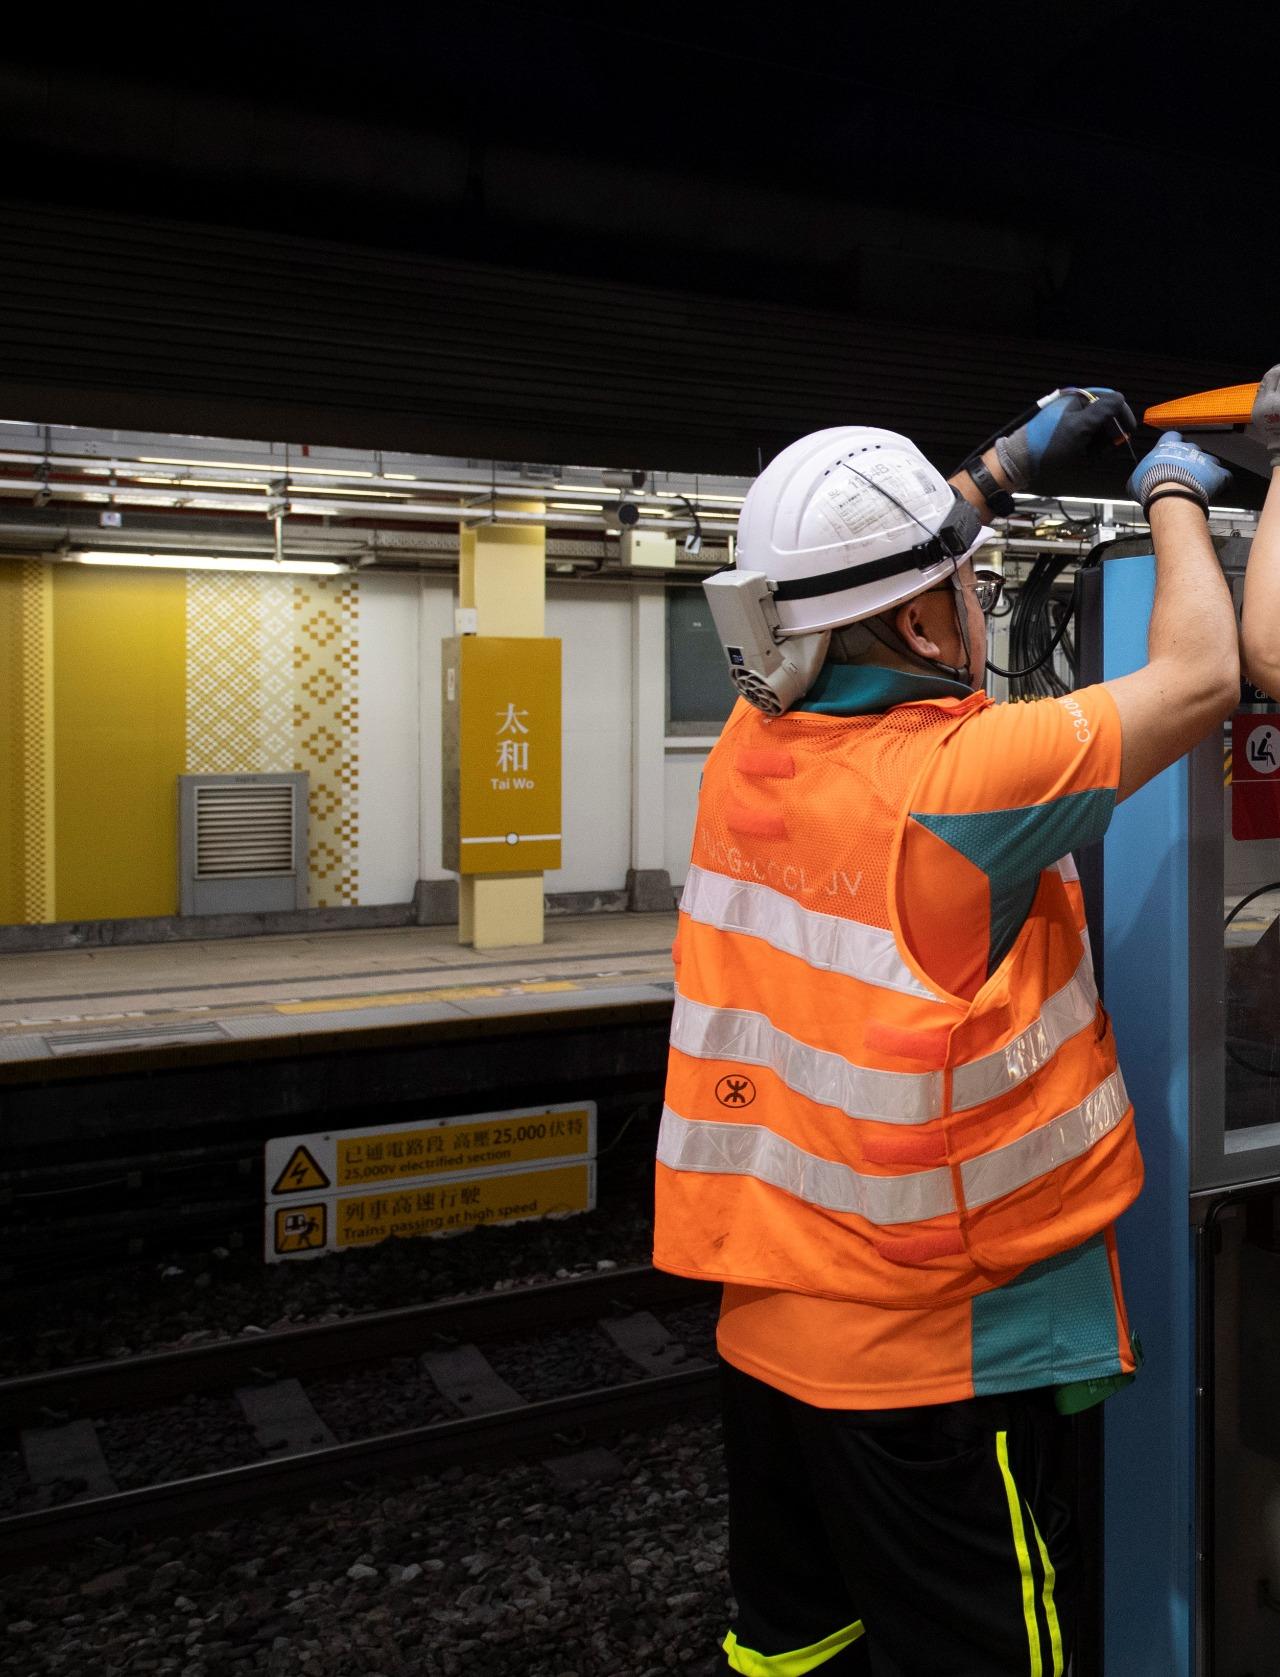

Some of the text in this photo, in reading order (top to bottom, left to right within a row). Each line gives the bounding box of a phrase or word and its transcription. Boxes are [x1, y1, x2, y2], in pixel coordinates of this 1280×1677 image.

[496, 703, 529, 773] 太和
[491, 778, 534, 790] Tai Wo
[400, 1154, 464, 1172] electrified
[467, 1149, 512, 1164] section
[344, 1201, 538, 1241] Trains passing at high speed
